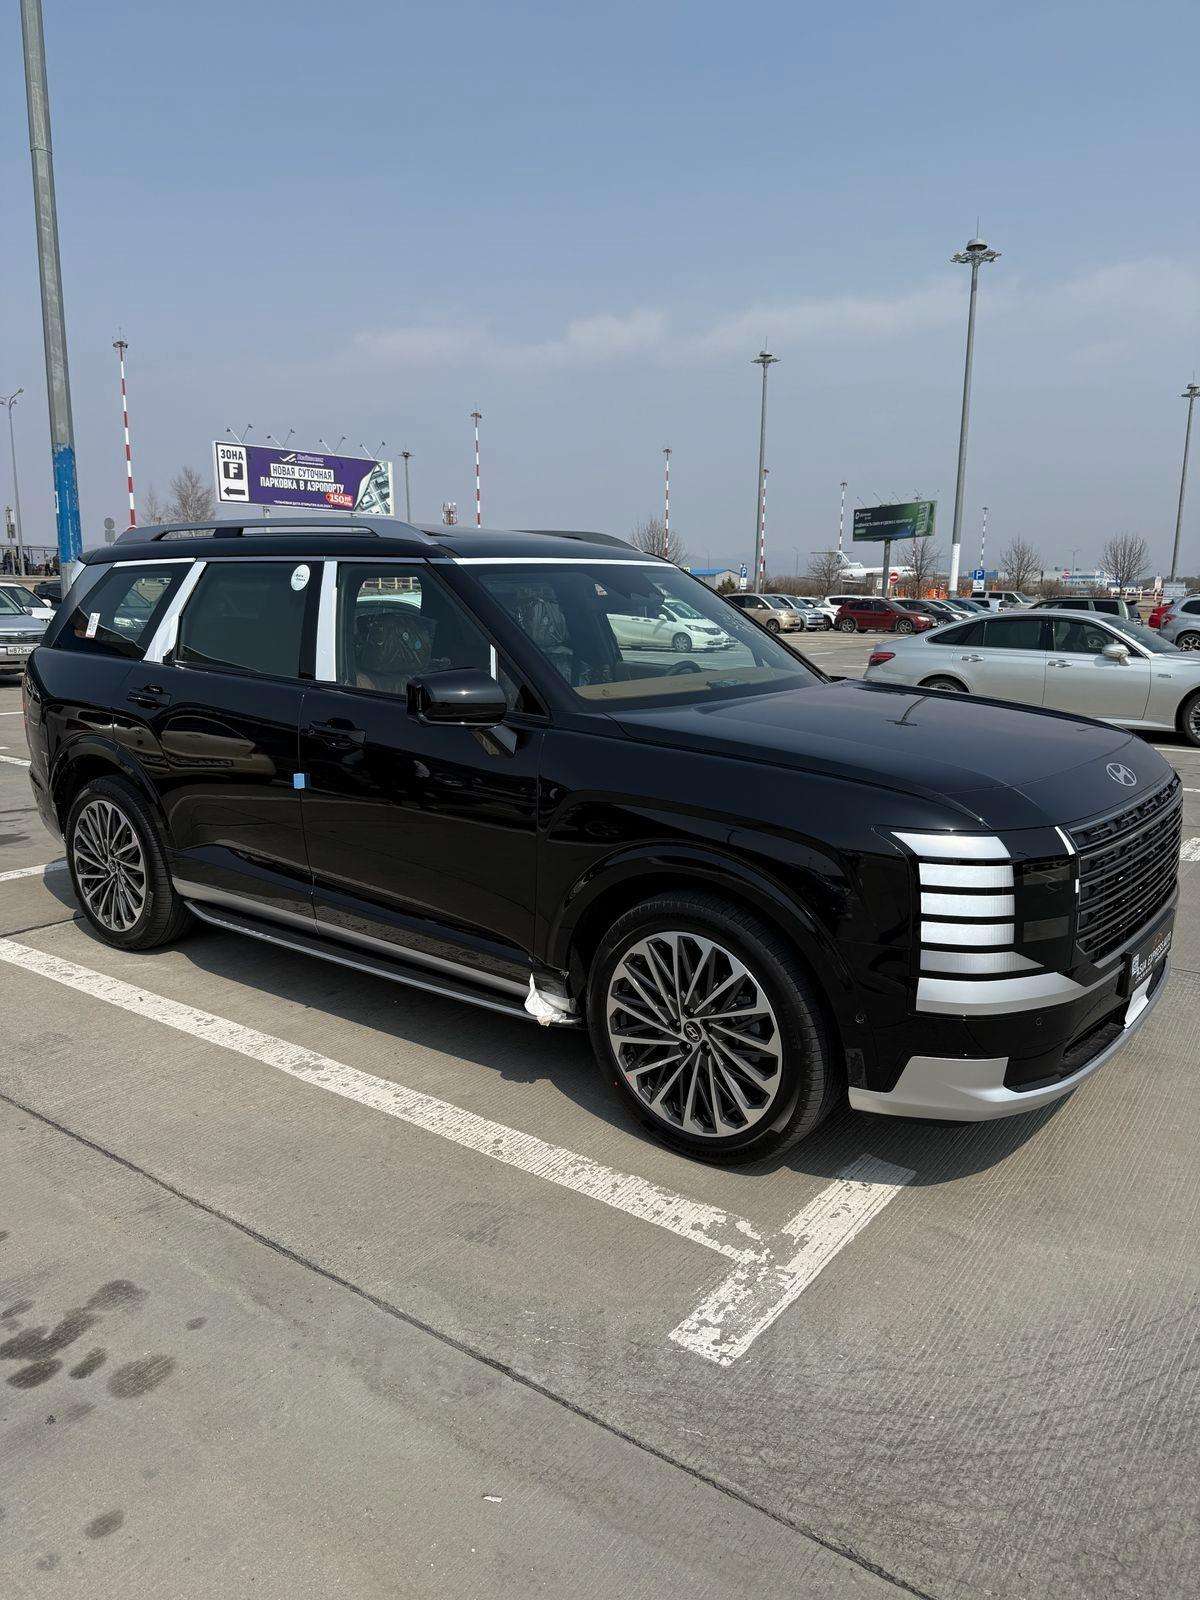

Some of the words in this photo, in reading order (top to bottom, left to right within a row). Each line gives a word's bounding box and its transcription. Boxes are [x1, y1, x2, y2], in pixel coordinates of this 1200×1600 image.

[220, 449, 244, 461] ЗОНА
[229, 463, 239, 478] F
[272, 464, 296, 476] НОВАЯ
[298, 466, 332, 480] СУТОЧНАЯ
[260, 476, 298, 490] ПАРКОВКА
[299, 481, 305, 491] В
[307, 481, 345, 494] АЭРОПОРТУ
[330, 494, 345, 504] 150
[976, 570, 983, 579] P
